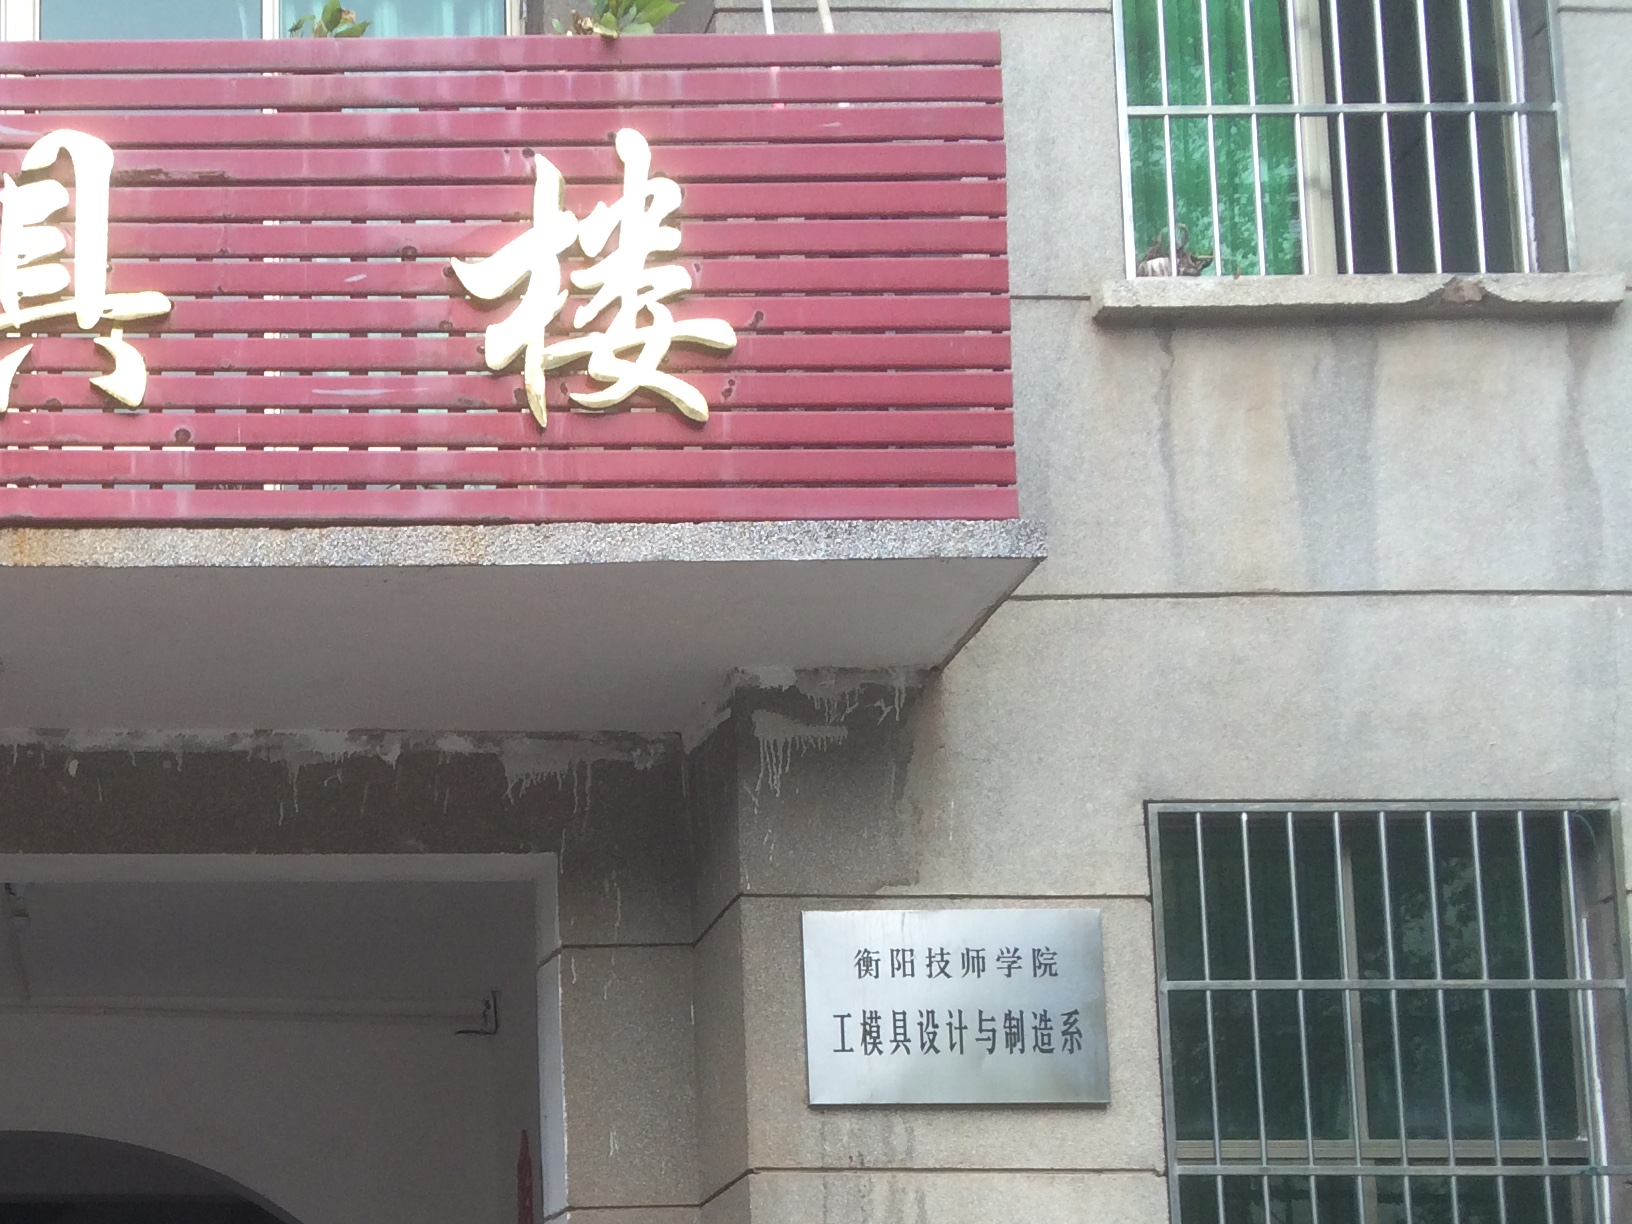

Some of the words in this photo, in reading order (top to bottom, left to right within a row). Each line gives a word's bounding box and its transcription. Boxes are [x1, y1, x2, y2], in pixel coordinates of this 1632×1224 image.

[853, 946, 1059, 980] 衡阳技师学院
[832, 1008, 1084, 1056] 工模具设计与制造系
